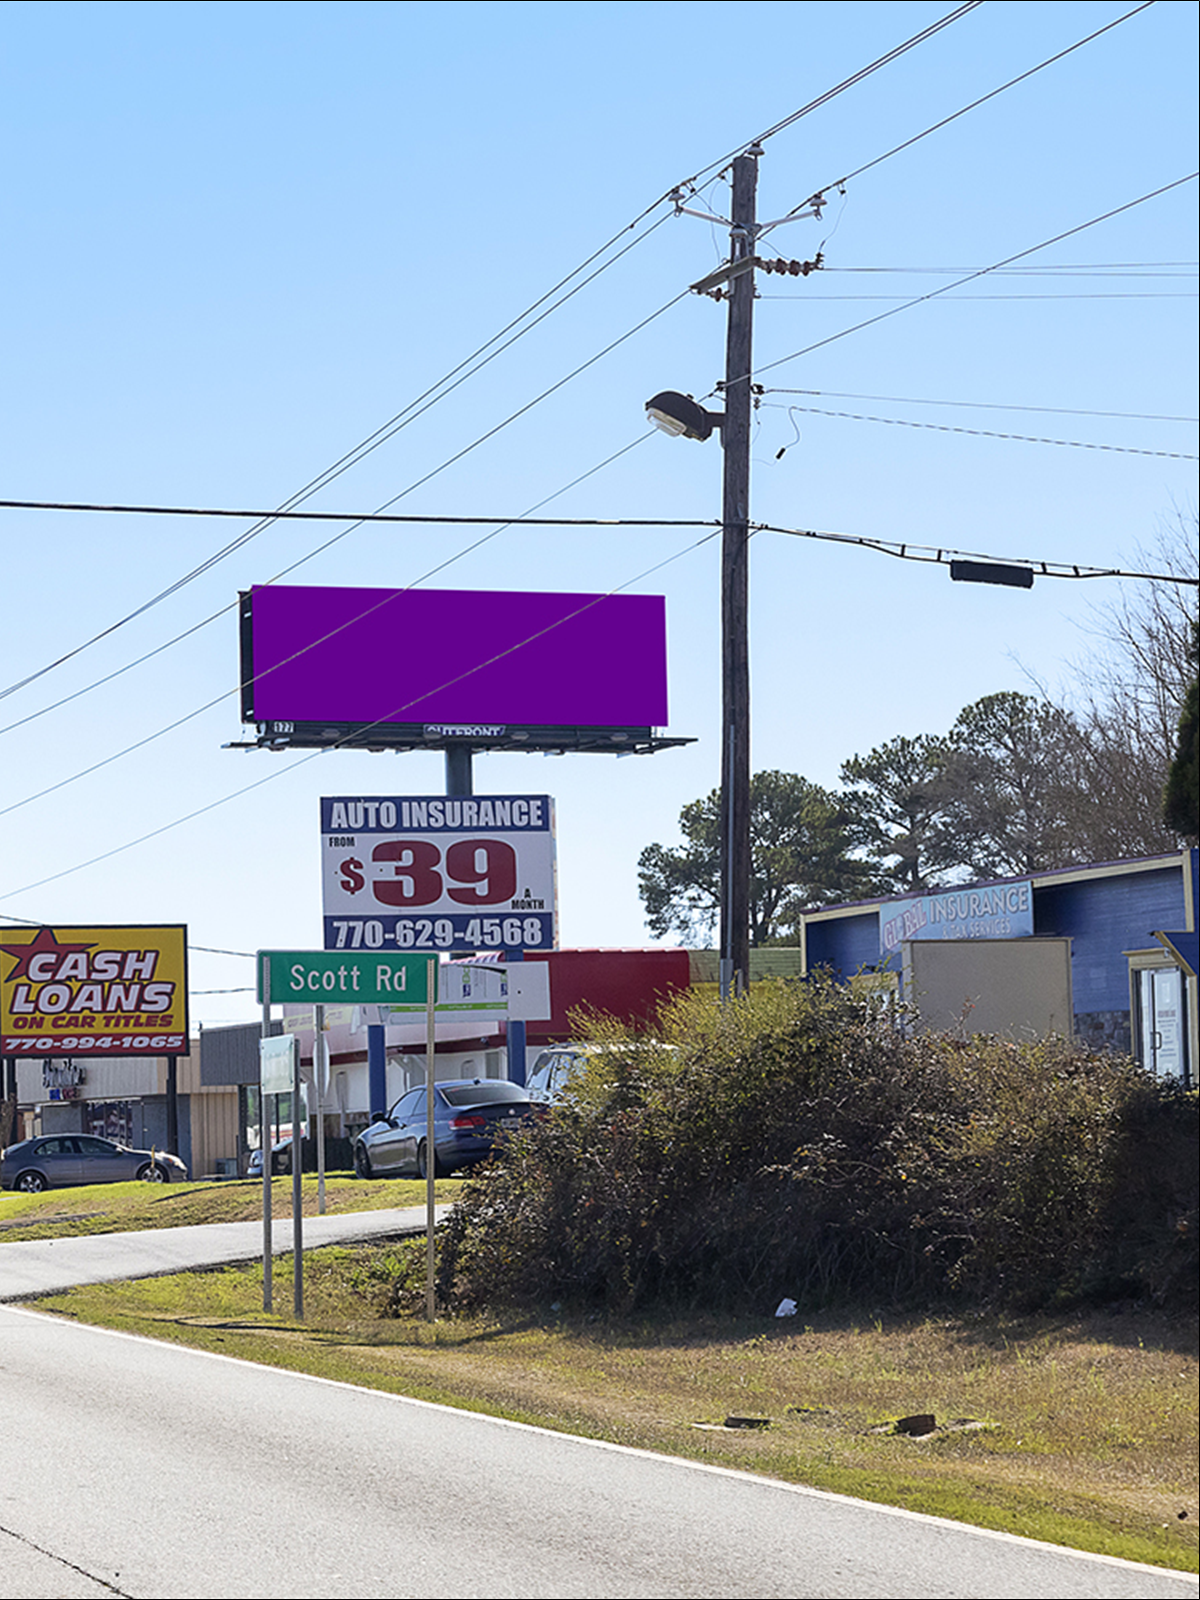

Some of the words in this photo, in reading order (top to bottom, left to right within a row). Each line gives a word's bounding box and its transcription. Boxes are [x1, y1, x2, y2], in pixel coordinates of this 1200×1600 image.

[331, 799, 397, 829] AUTO
[402, 798, 543, 829] INSURANCE
[329, 836, 355, 848] FROM
[511, 899, 545, 910] MONTH
[524, 888, 532, 899] A
[929, 885, 1030, 924] INSURANCE
[332, 917, 543, 949] 770-629-4568
[951, 921, 969, 939] TAX
[969, 916, 1012, 939] SERVICES
[27, 951, 158, 982] CASH
[289, 963, 361, 991] Scott
[376, 964, 407, 992] Rd
[10, 982, 176, 1014] LOANS
[12, 1016, 45, 1029] ON
[51, 1016, 97, 1029] CAR
[103, 1014, 174, 1028] TITLES
[4, 1035, 184, 1050] 770-994-1065
